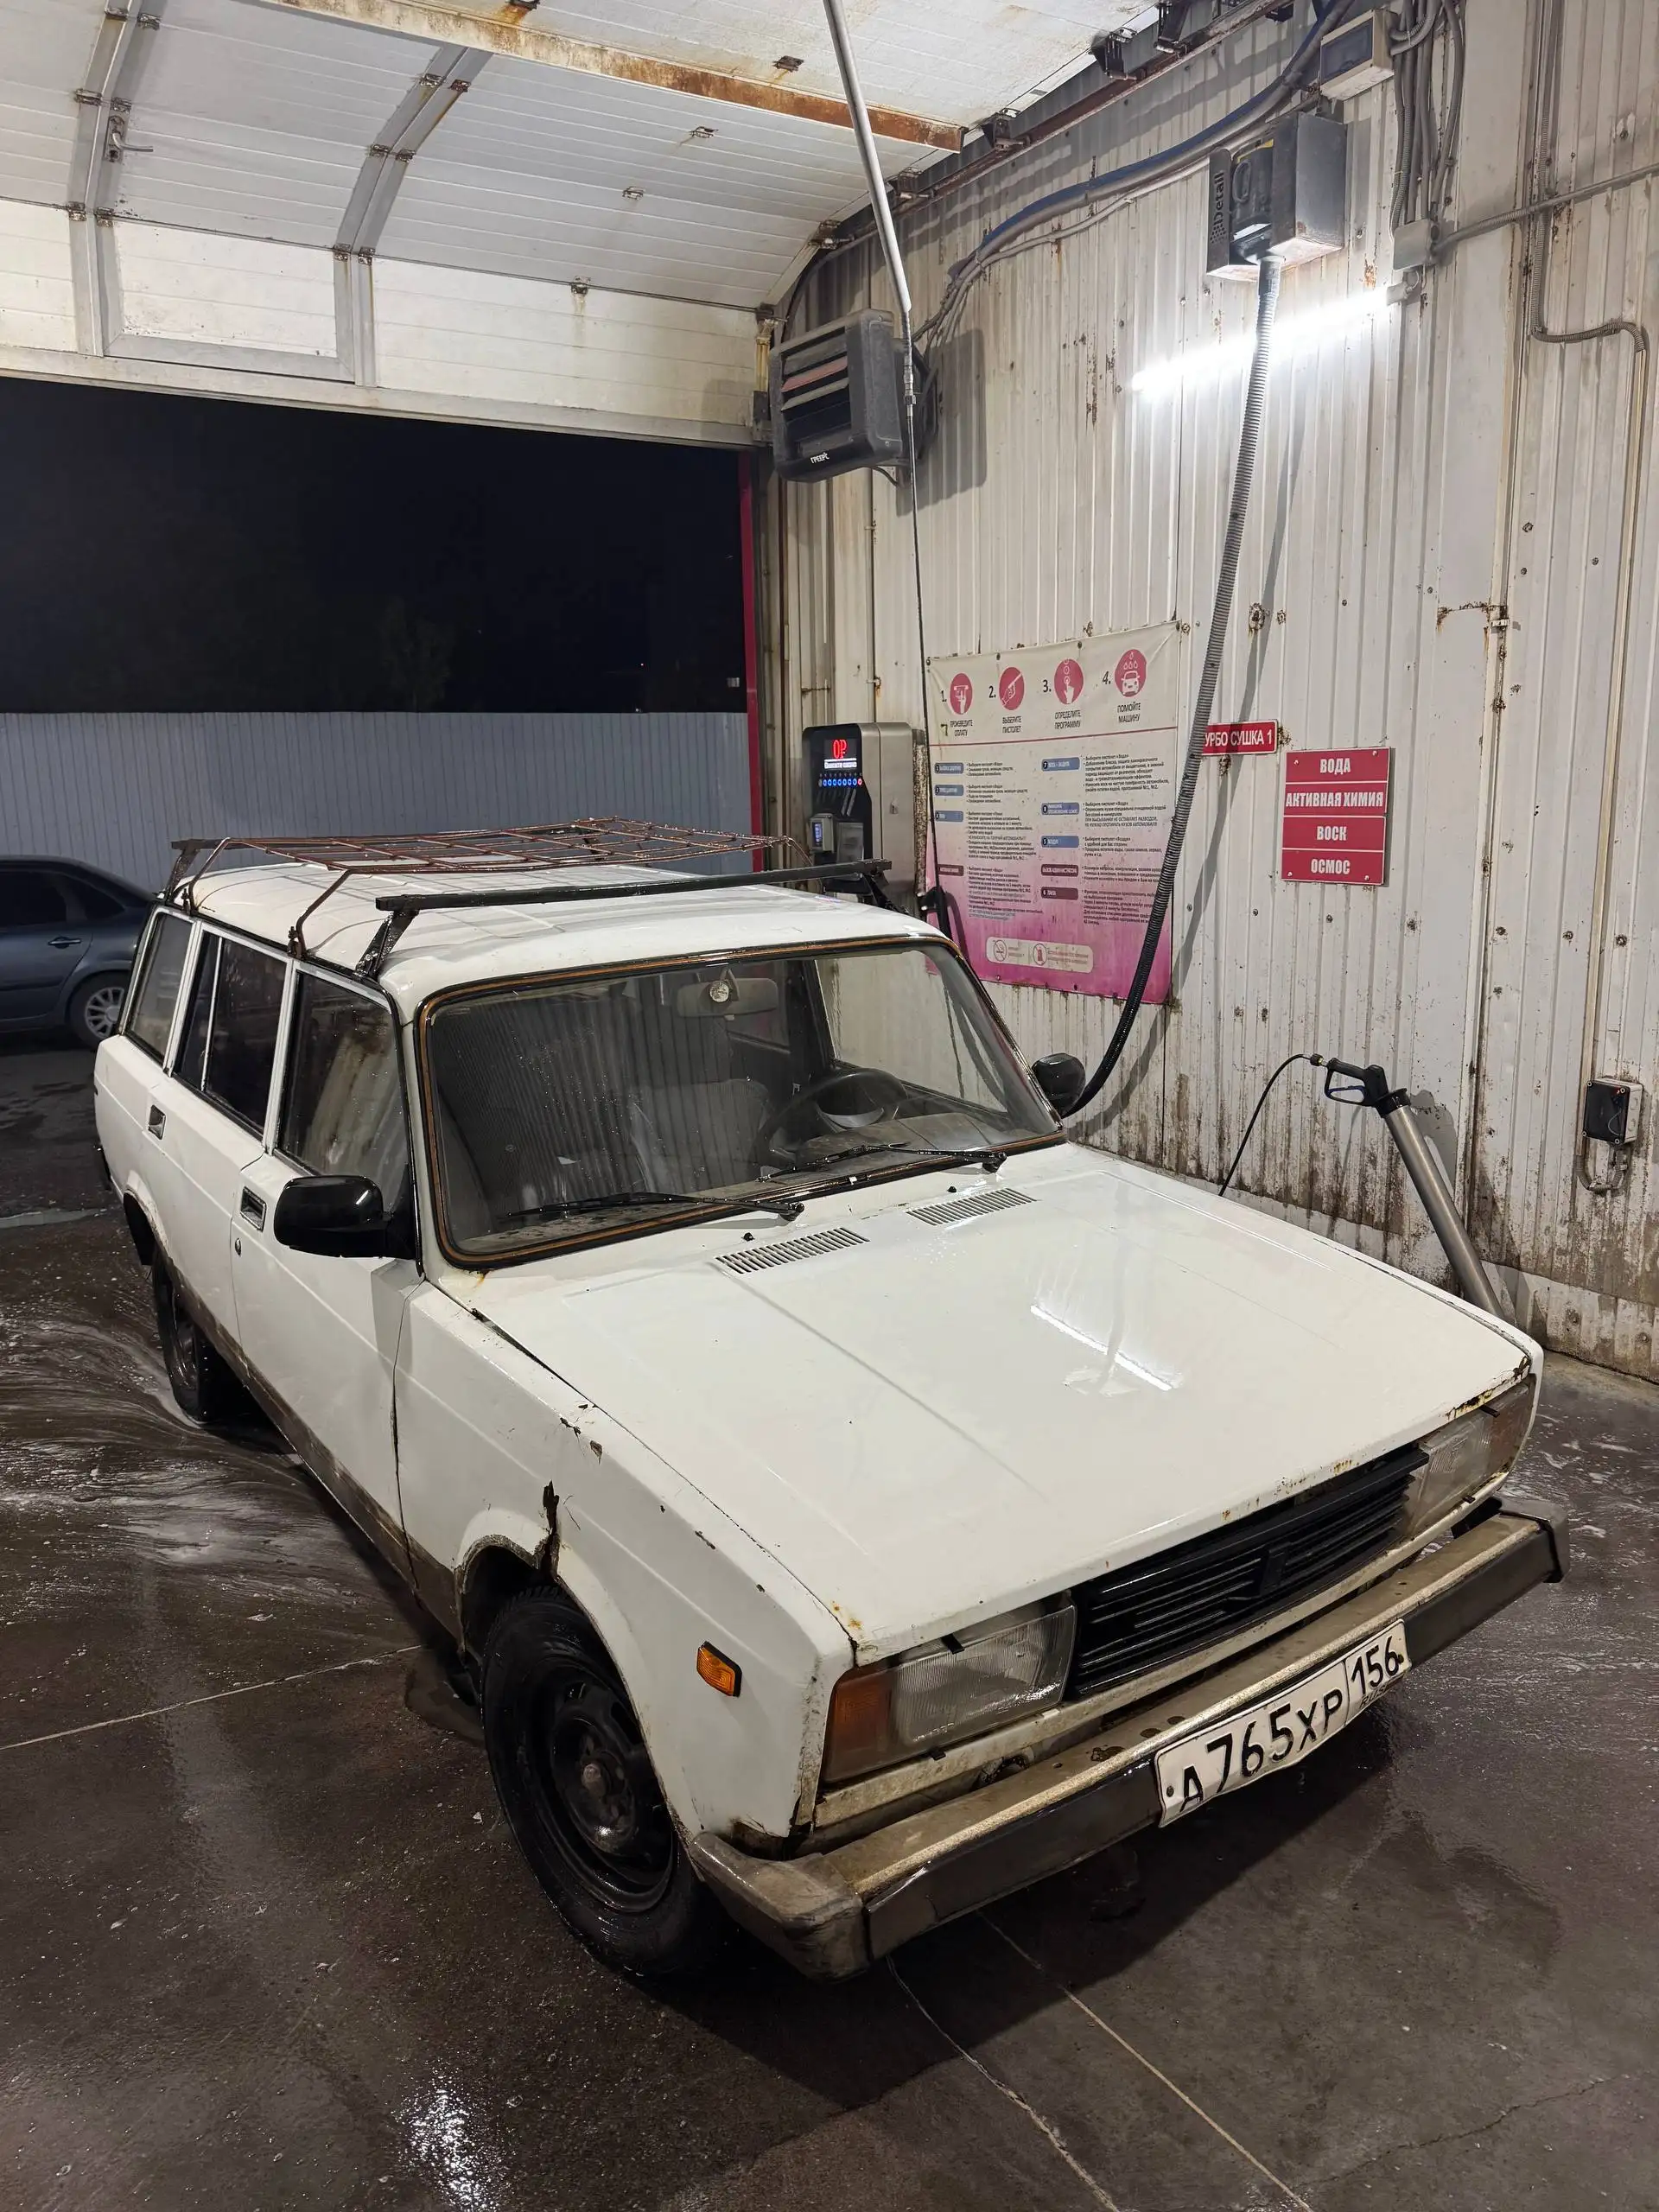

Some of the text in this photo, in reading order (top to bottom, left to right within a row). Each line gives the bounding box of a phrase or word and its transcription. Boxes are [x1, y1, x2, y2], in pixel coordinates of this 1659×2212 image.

[1213, 171, 1224, 226] Detail
[1116, 702, 1141, 714] ПОМОЙТЕ
[1118, 714, 1141, 724] МАШИНУ
[1205, 728, 1273, 747] УРБО СУШКА 1
[1319, 758, 1351, 775] ВОДА
[1285, 791, 1384, 807] АКТИВНАЯ ХИМИЯ
[1316, 826, 1348, 841] ВОСК
[1310, 859, 1351, 874] ОСМОС
[1351, 1636, 1401, 1695] 156
